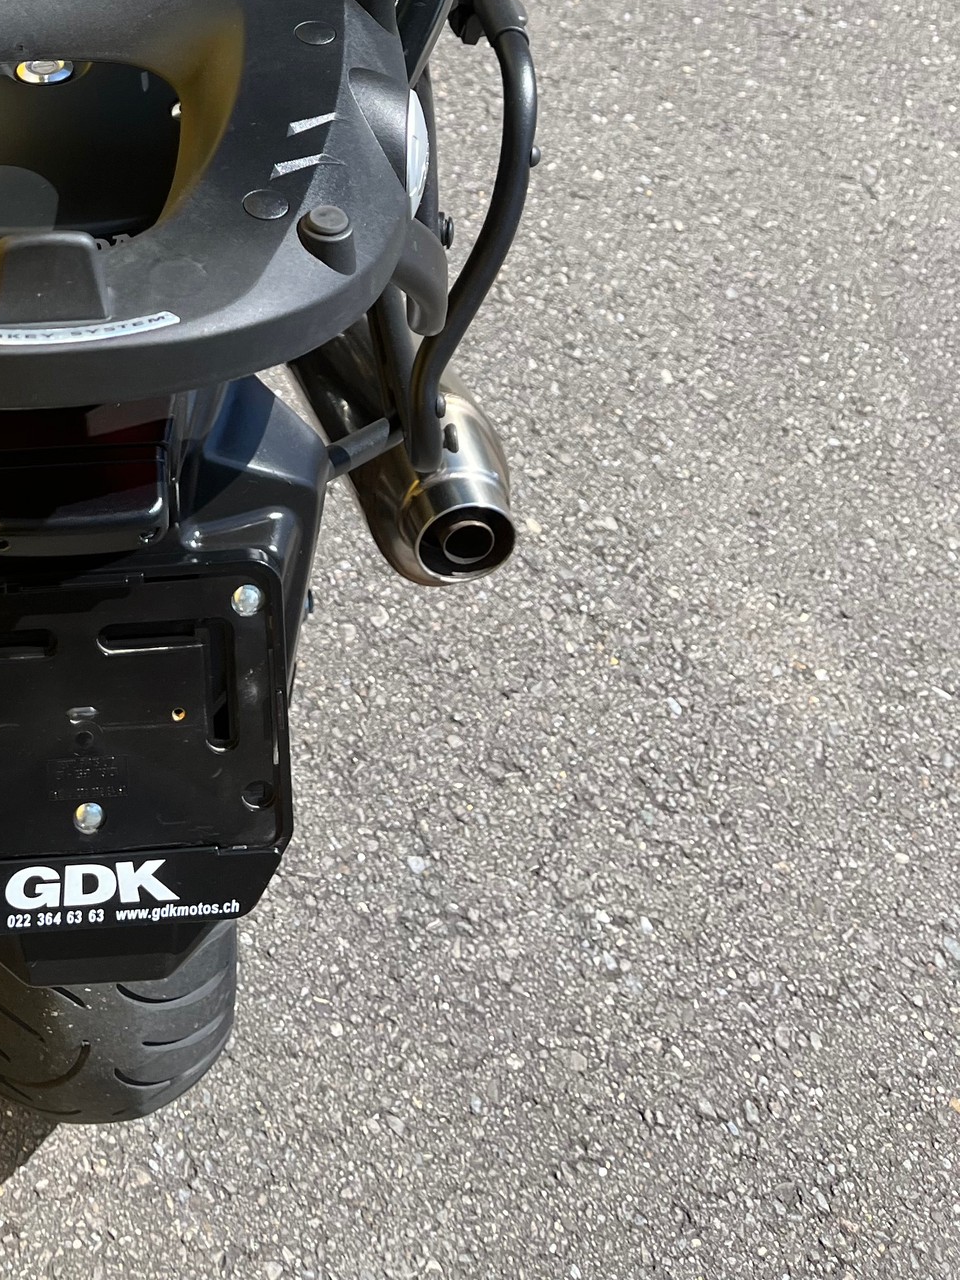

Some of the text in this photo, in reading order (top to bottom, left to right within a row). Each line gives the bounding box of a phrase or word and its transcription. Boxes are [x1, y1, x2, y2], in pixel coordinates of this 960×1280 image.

[70, 315, 166, 336] SYSTEM
[4, 858, 181, 910] GDK
[7, 914, 31, 928] 022
[37, 912, 62, 926] 364
[66, 910, 83, 924] 63
[88, 909, 105, 923] 63
[115, 899, 240, 922] www.gdkmotos.ch
